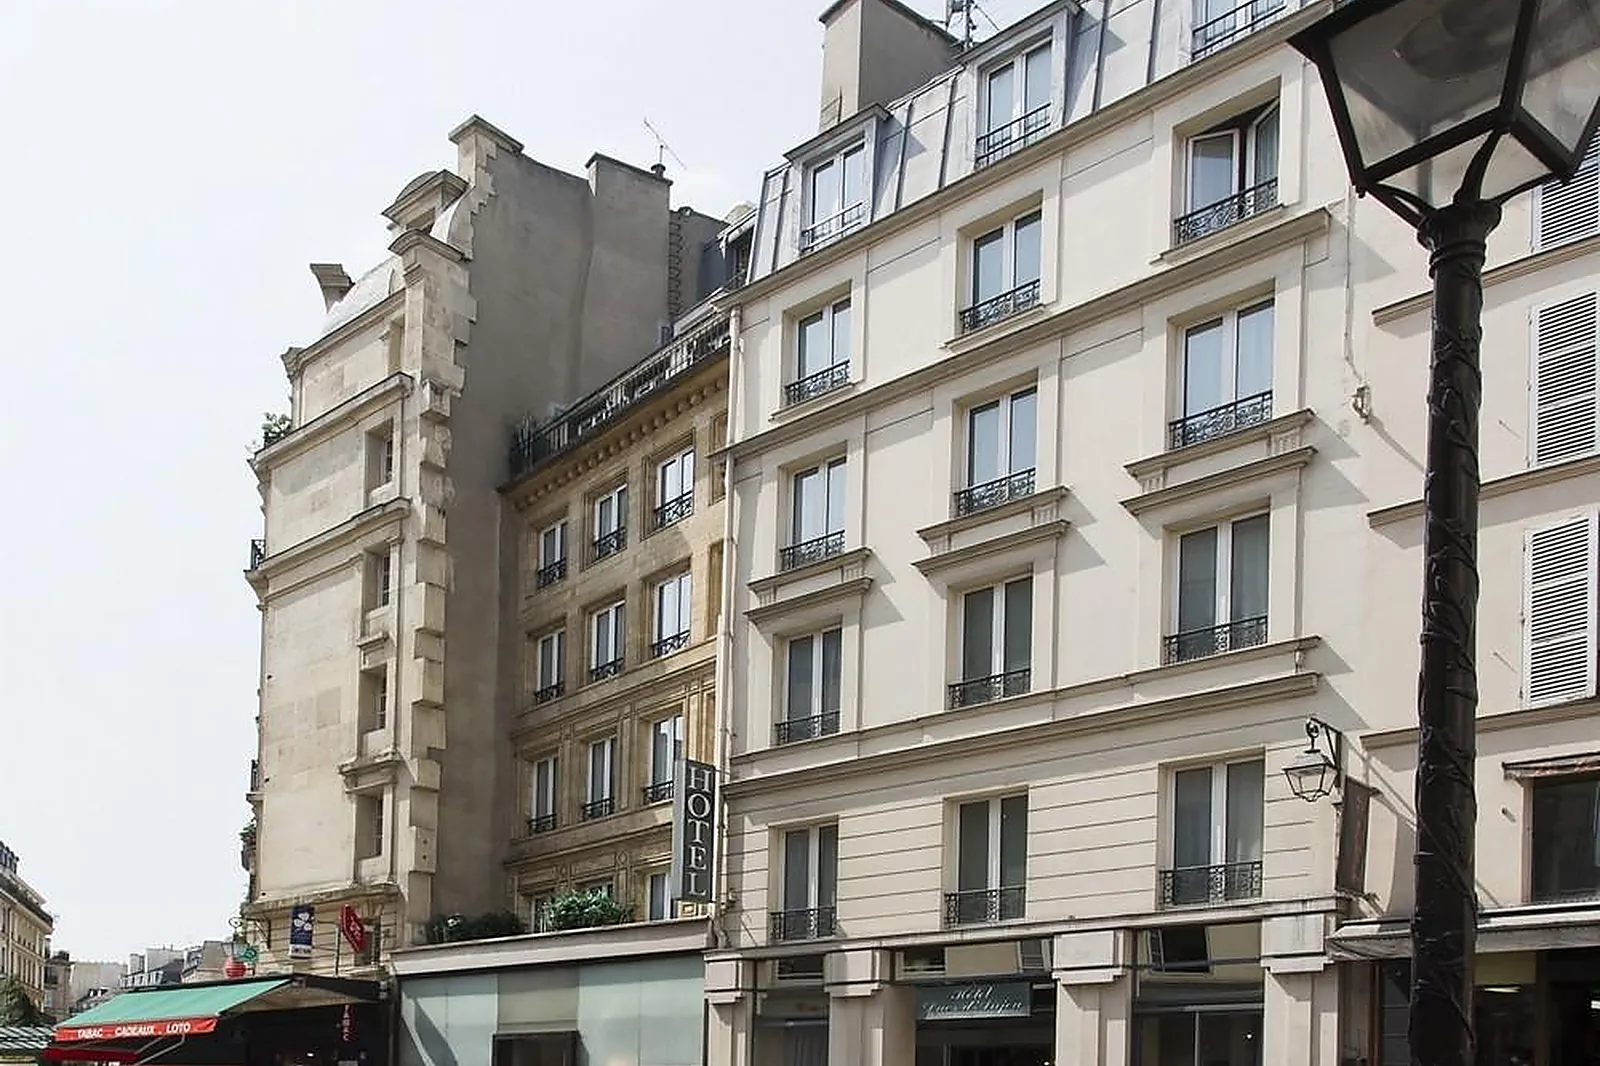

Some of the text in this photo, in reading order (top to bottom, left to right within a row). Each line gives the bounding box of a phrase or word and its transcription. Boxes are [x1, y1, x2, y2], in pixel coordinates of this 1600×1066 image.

[687, 766, 712, 896] HOTEL
[77, 1022, 191, 1040] TABAC CADEAUX LOTO
